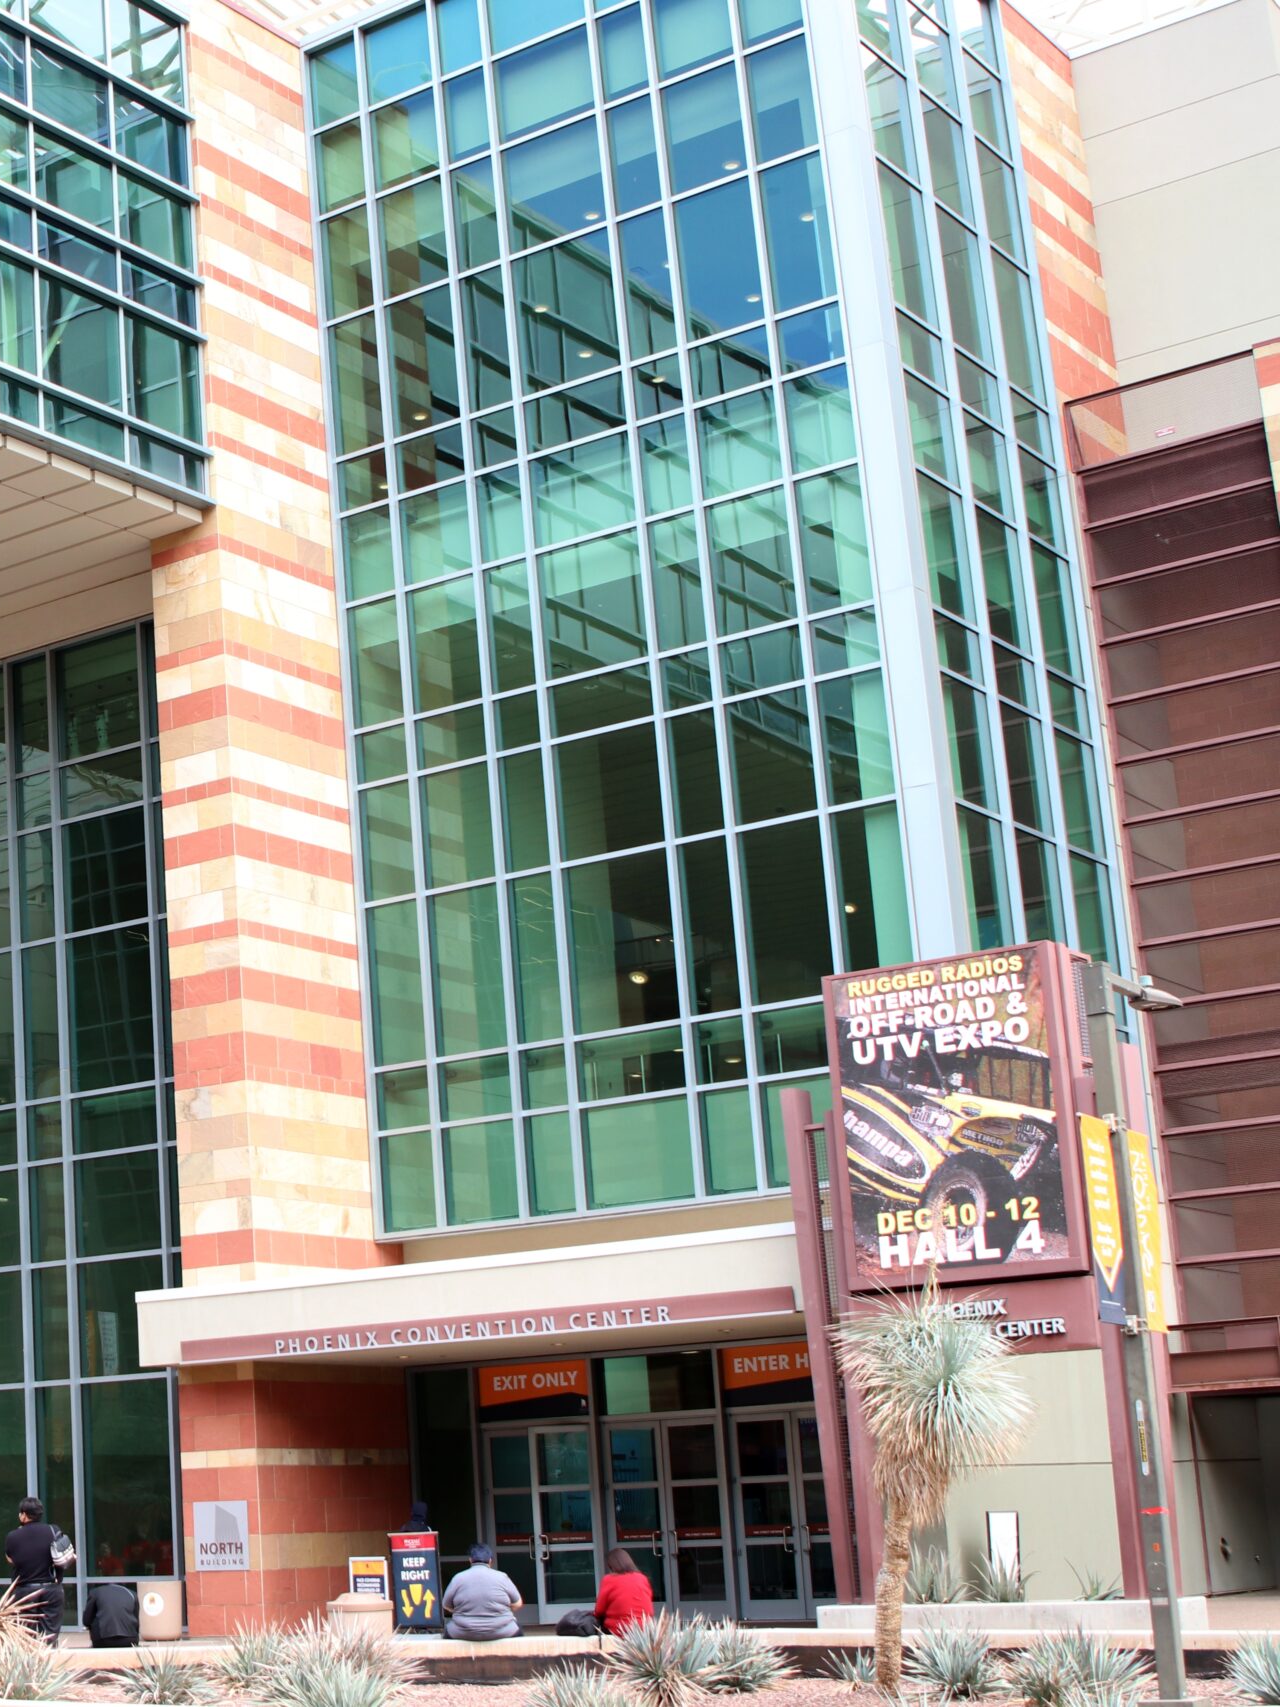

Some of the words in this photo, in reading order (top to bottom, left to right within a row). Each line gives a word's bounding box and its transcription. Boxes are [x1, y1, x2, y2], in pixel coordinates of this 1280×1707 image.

[848, 970, 935, 998] RUGGED
[941, 955, 1024, 983] RADIOS
[849, 973, 1025, 1015] INTERNATIONAL
[850, 997, 996, 1038] OFF-ROAD
[1006, 991, 1029, 1015] &
[852, 1031, 923, 1065] UTV
[934, 1016, 1030, 1054] EXPO
[876, 1208, 933, 1236] DEC
[944, 1203, 977, 1228] 10
[1005, 1196, 1041, 1221] 12
[878, 1225, 1002, 1269] HALL
[1016, 1219, 1046, 1254] 4
[275, 1331, 380, 1355] PHOENIX
[391, 1315, 556, 1345] CONVENTION
[569, 1305, 671, 1330] CENTER
[995, 1317, 1067, 1338] CENTER
[733, 1354, 790, 1373] ENTER
[492, 1372, 528, 1392] EXIT
[532, 1370, 578, 1388] ONLY
[200, 1541, 243, 1555] NORTH
[200, 1558, 244, 1566] BUILDING
[402, 1557, 426, 1568] KEEP
[400, 1569, 430, 1581] RIGHT
